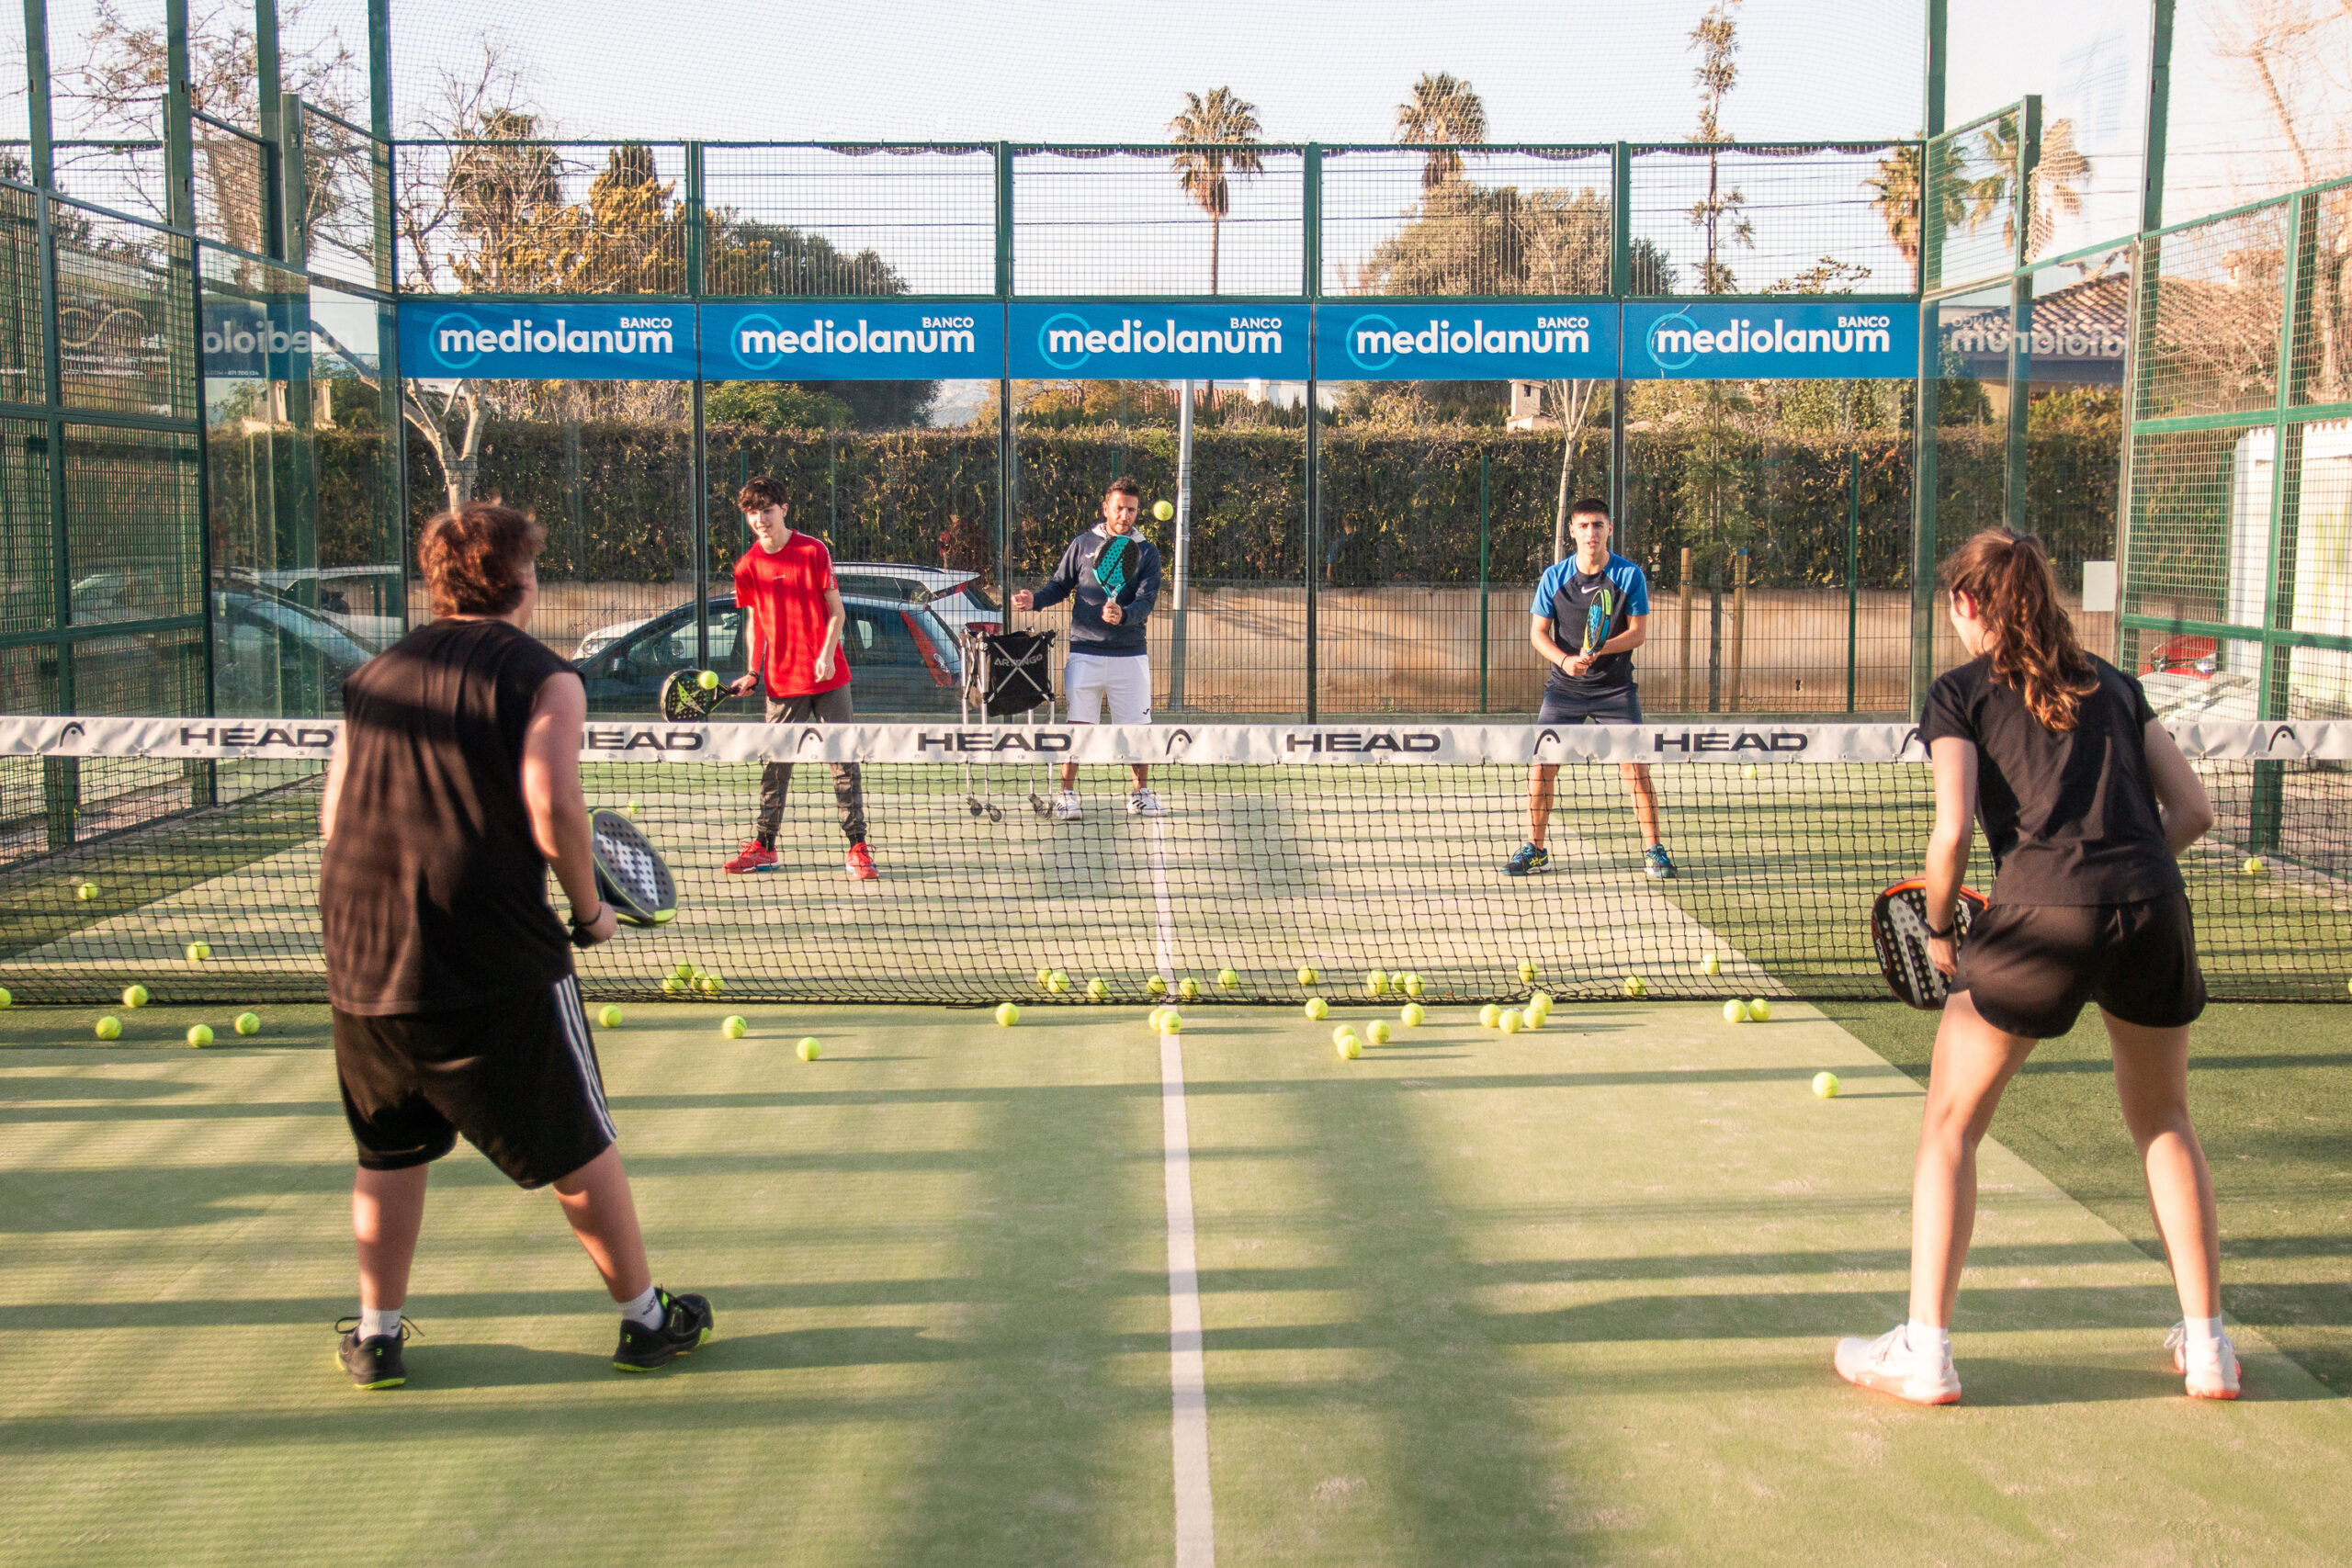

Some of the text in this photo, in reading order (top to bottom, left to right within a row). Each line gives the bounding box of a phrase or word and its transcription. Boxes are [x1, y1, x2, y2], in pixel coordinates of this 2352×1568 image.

[621, 317, 673, 329] BANCO
[922, 317, 975, 329] BANCO
[1230, 317, 1283, 330] BANCO
[1538, 317, 1589, 329] BANCO
[1838, 316, 1890, 328] BANCO
[440, 319, 673, 354] mediolanum
[741, 319, 975, 354] mediolanum
[1049, 319, 1283, 354] mediolanum
[1357, 320, 1589, 355] mediolanum
[1657, 318, 1891, 354] mediolanum
[180, 727, 335, 749] HEAD
[581, 731, 704, 751] EAD
[919, 732, 1072, 752] HEAD
[1287, 733, 1441, 753] HEAD
[1655, 732, 1808, 752] HEAD
